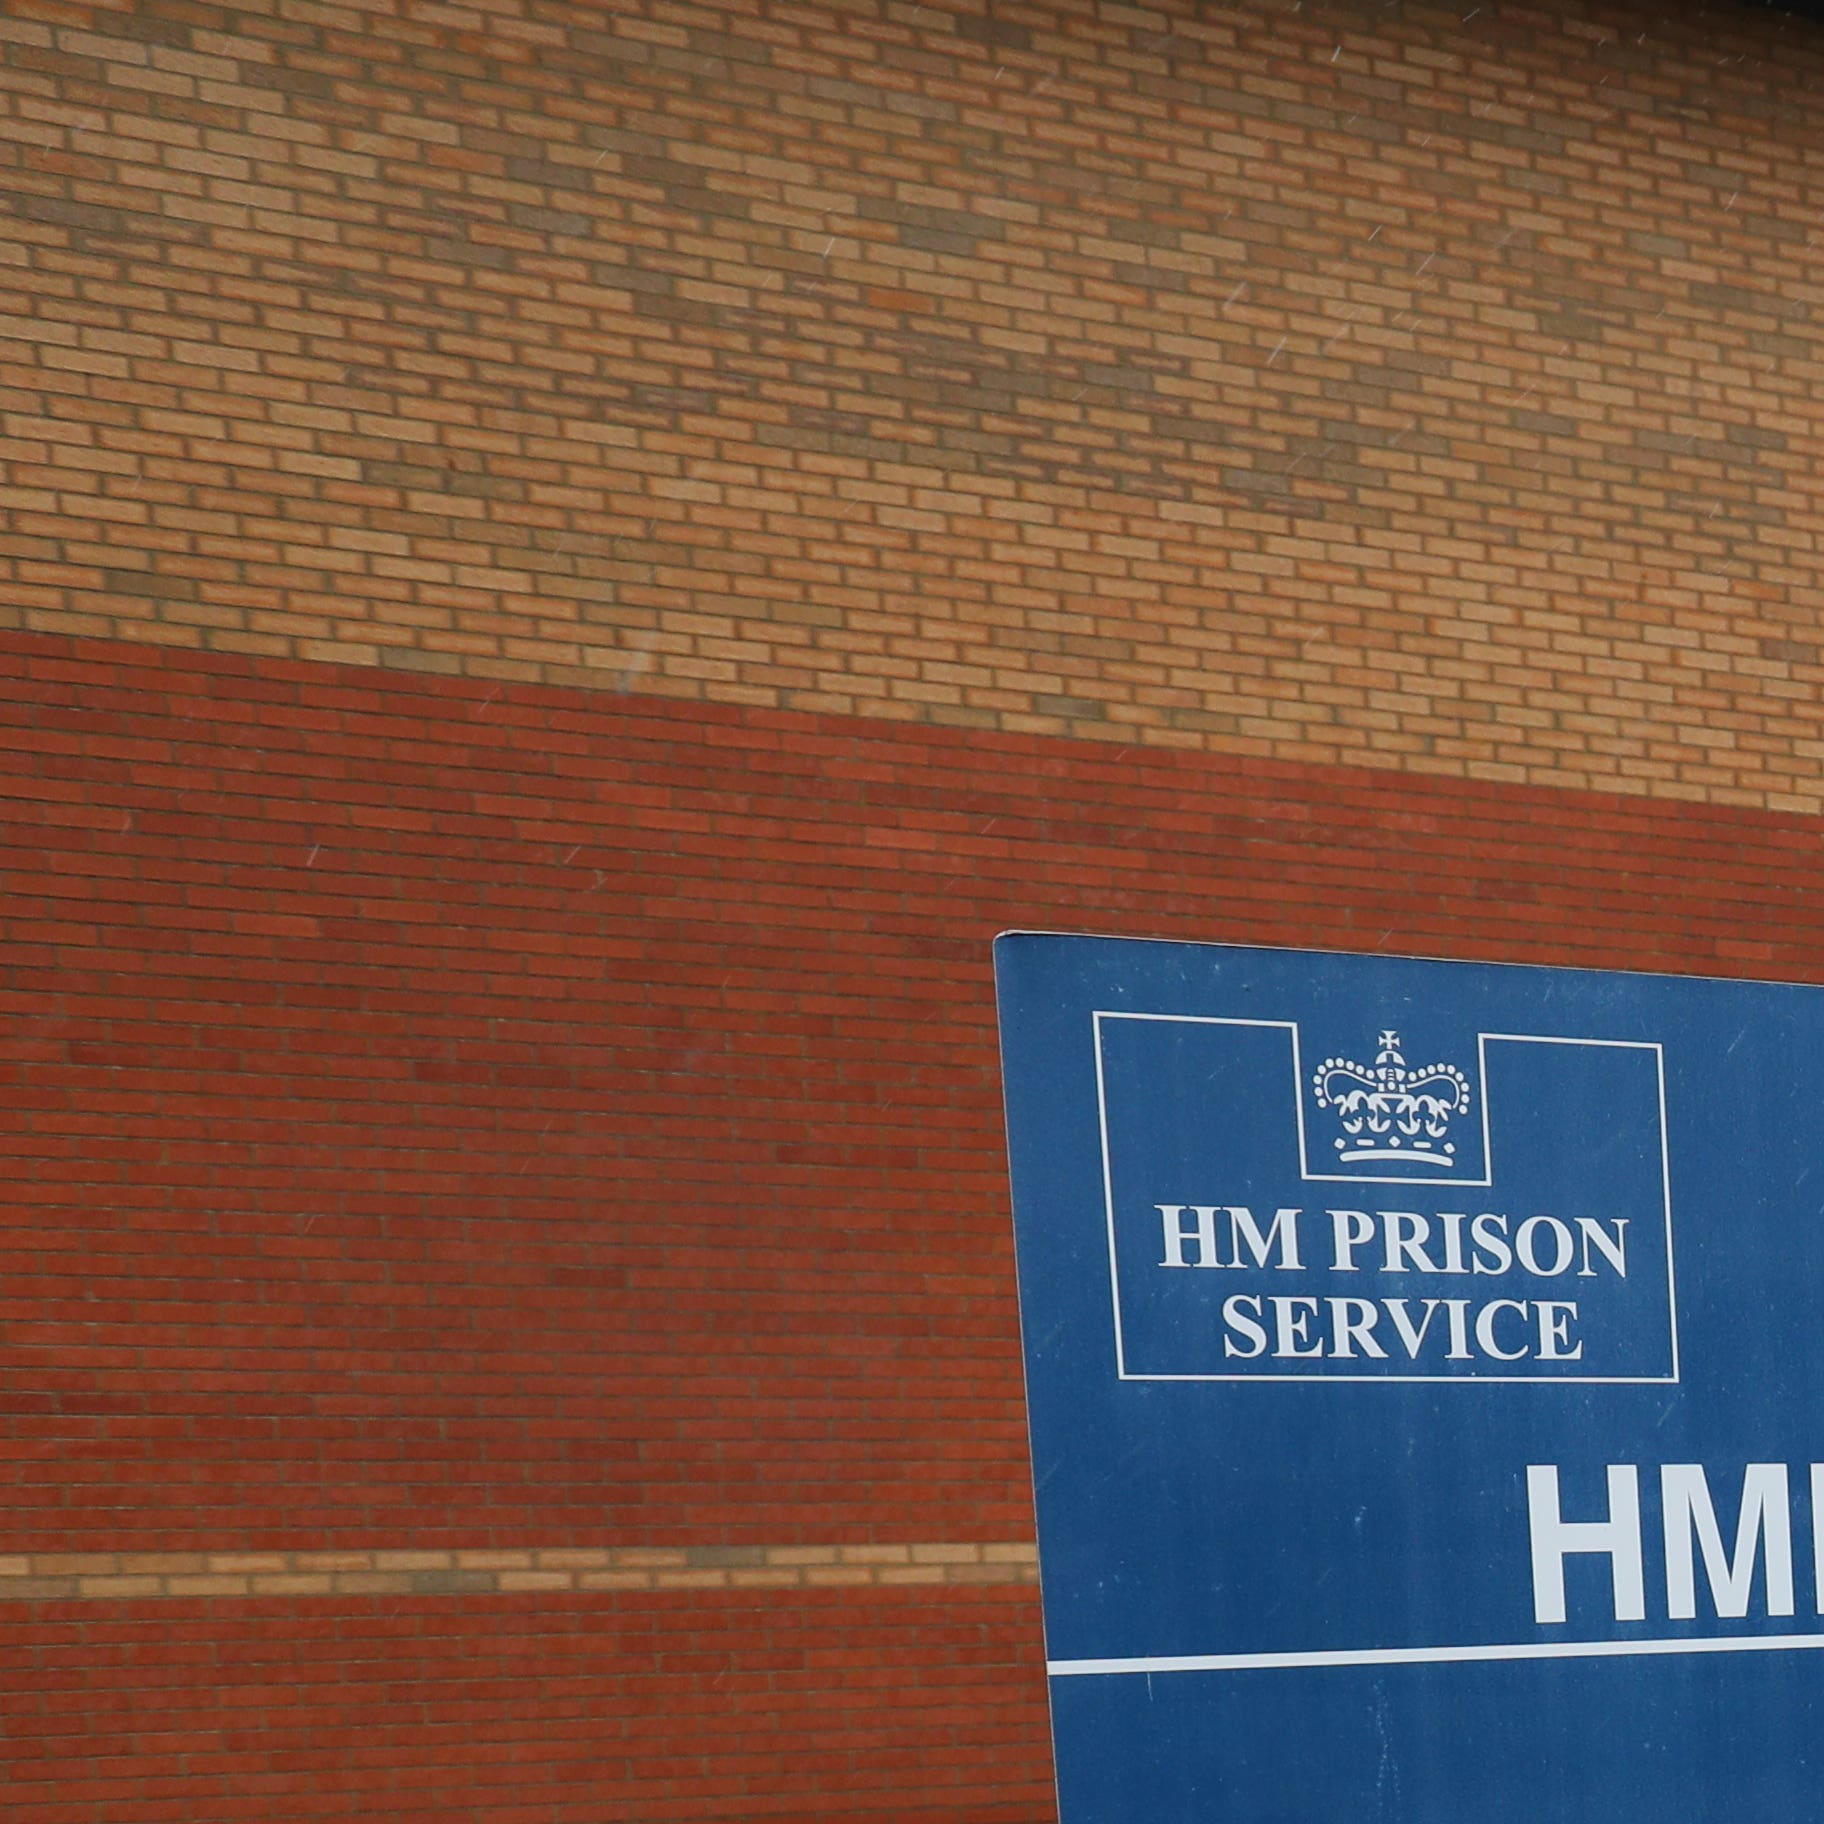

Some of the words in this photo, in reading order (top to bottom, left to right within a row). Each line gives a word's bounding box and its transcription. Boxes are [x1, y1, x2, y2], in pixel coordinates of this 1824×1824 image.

[1153, 1203, 1307, 1271] HM
[1324, 1209, 1631, 1279] PRISON
[1221, 1293, 1584, 1361] SERVICE
